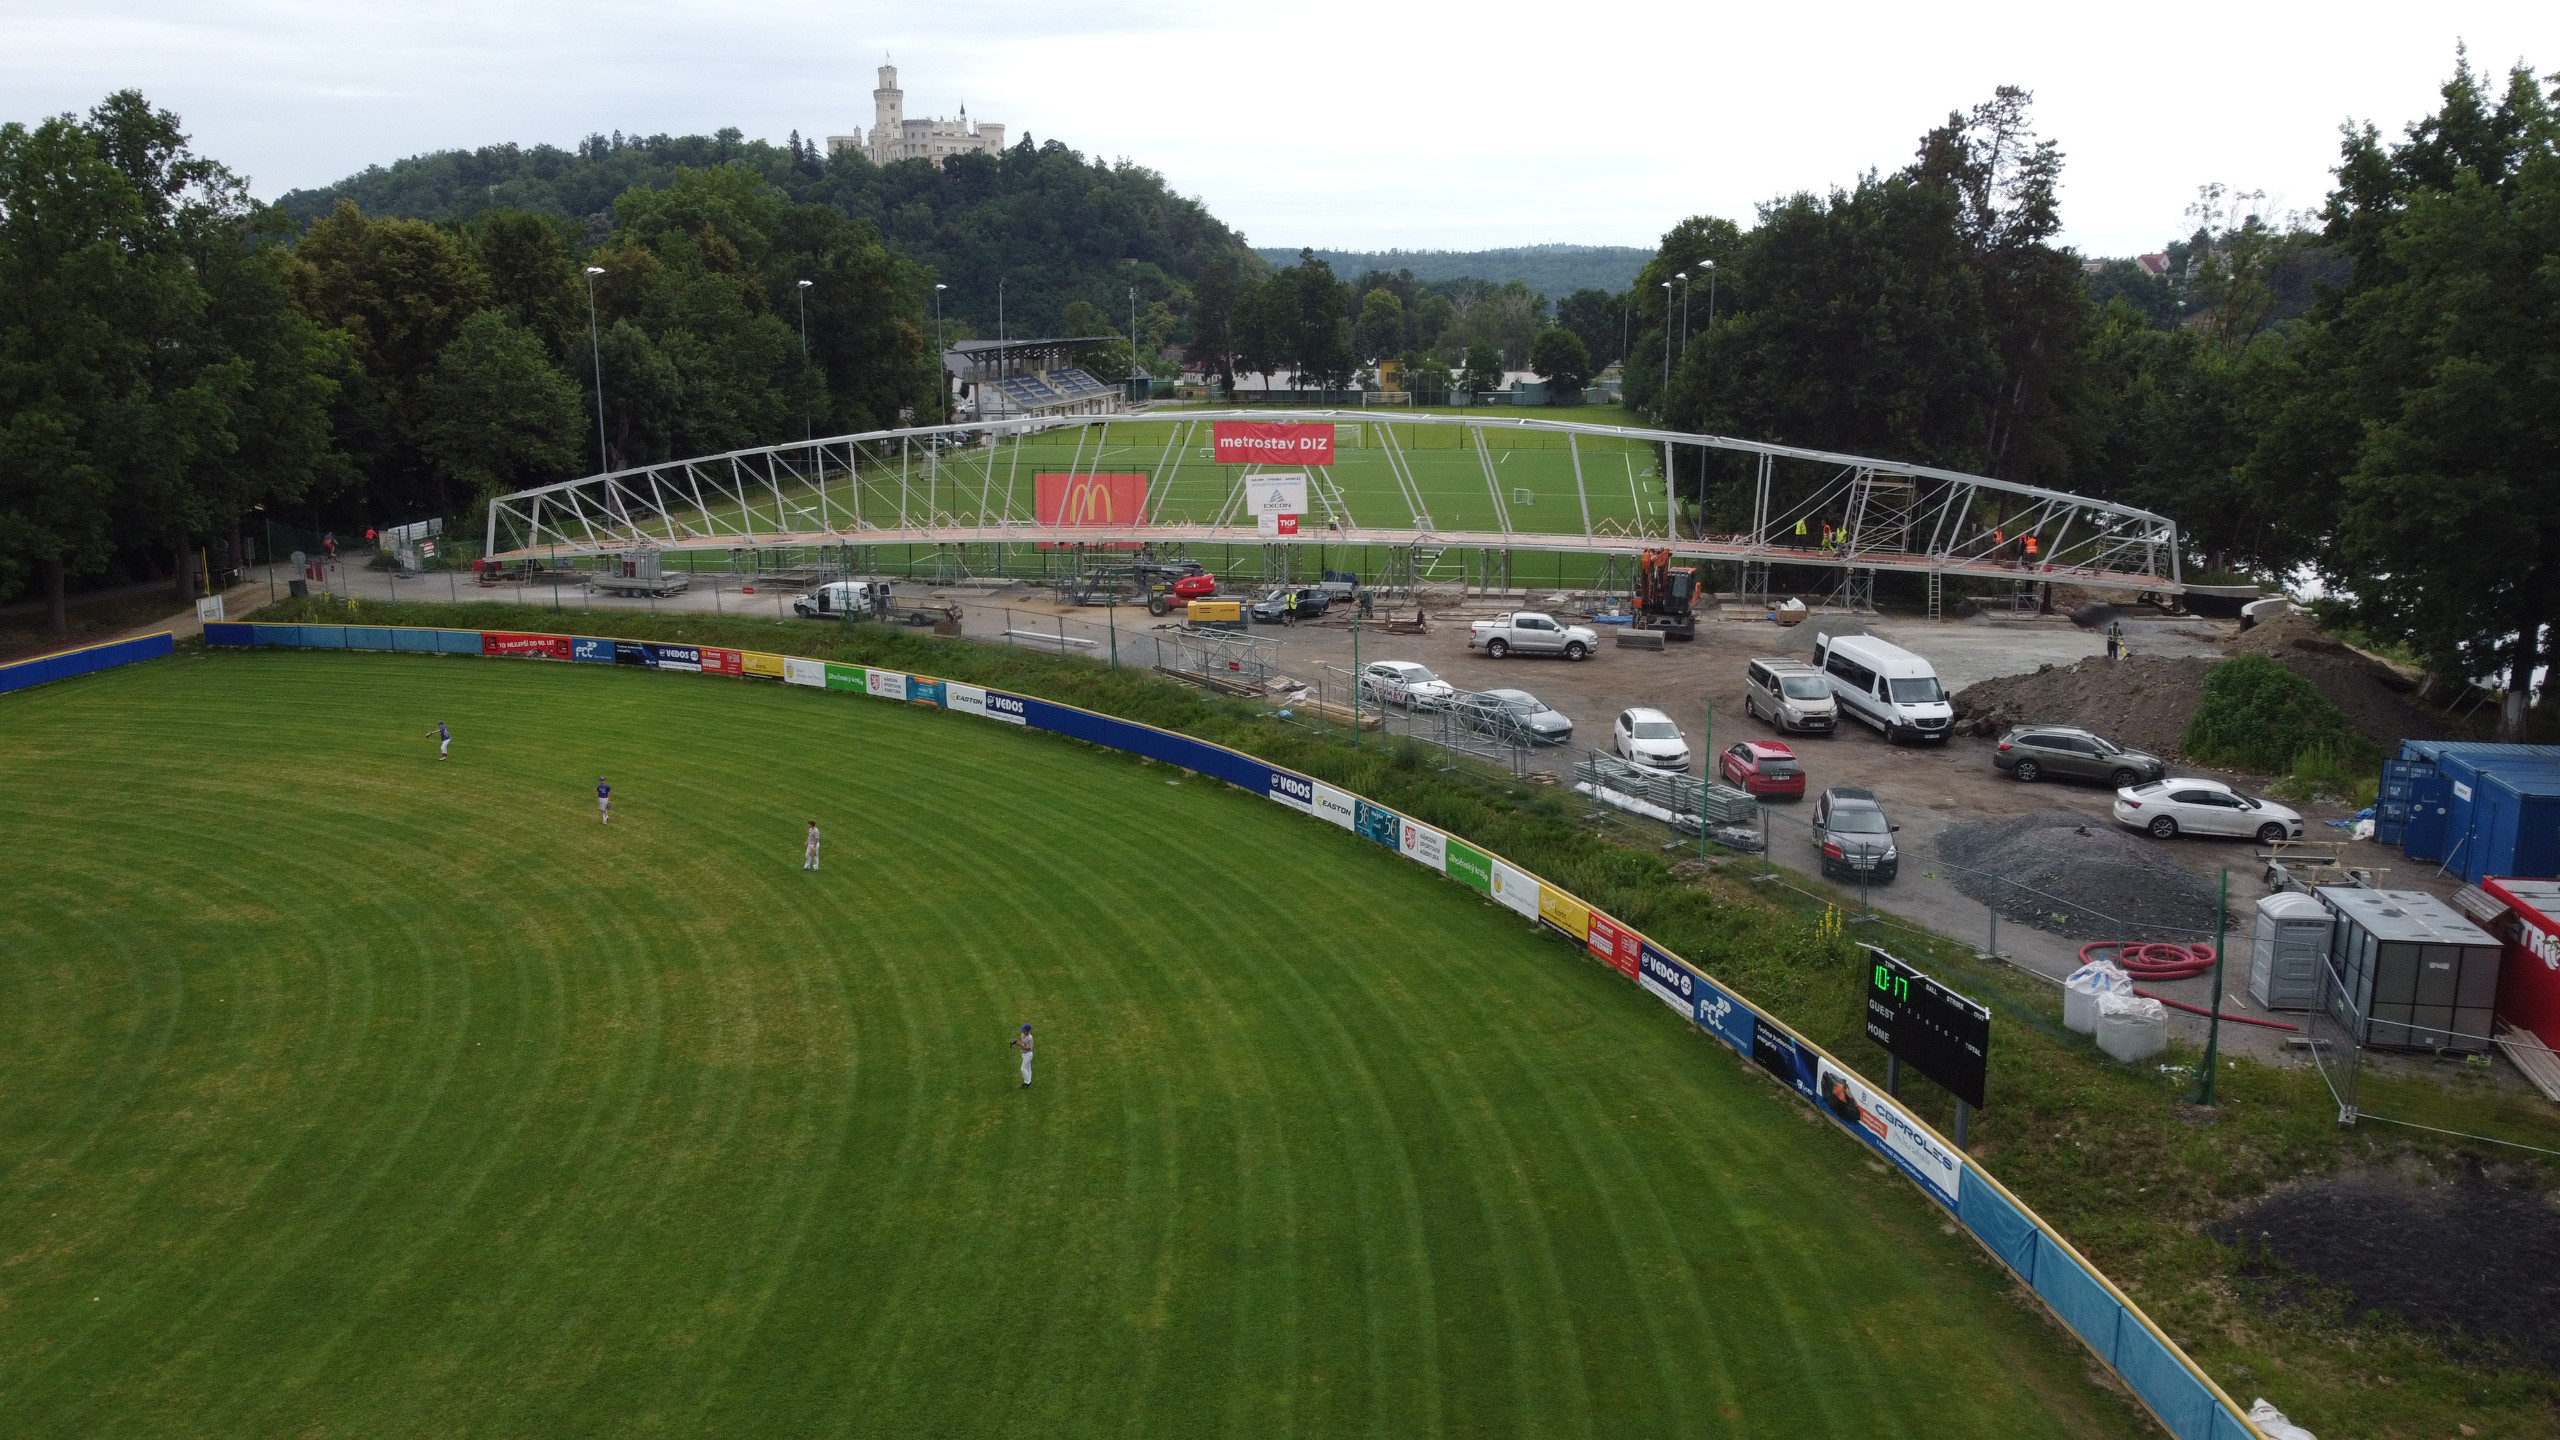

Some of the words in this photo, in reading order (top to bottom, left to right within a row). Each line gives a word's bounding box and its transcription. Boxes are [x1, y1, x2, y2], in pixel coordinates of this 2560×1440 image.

[1220, 436, 1296, 450] metrostav
[1300, 437, 1328, 450] DIZ
[1279, 519, 1296, 527] TKP
[575, 645, 594, 658] FCC
[665, 649, 690, 659] VEDOS
[955, 694, 983, 706] EASTON
[995, 697, 1024, 713] VEDOS
[1280, 776, 1311, 799] VEDOS
[1322, 799, 1352, 816] EASTON
[1650, 956, 1680, 987] VEDOS
[1874, 965, 1908, 1002] 10:17
[1869, 998, 1895, 1021] GUEST
[1925, 983, 1938, 996] BALL
[1946, 995, 1965, 1011] STRIKE
[1973, 1011, 1985, 1022] OUT
[1700, 999, 1724, 1031] FCC
[1867, 1021, 1890, 1044] HOME
[1965, 1042, 1982, 1057] TOTAL
[1875, 1103, 1953, 1171] CBPROLES
